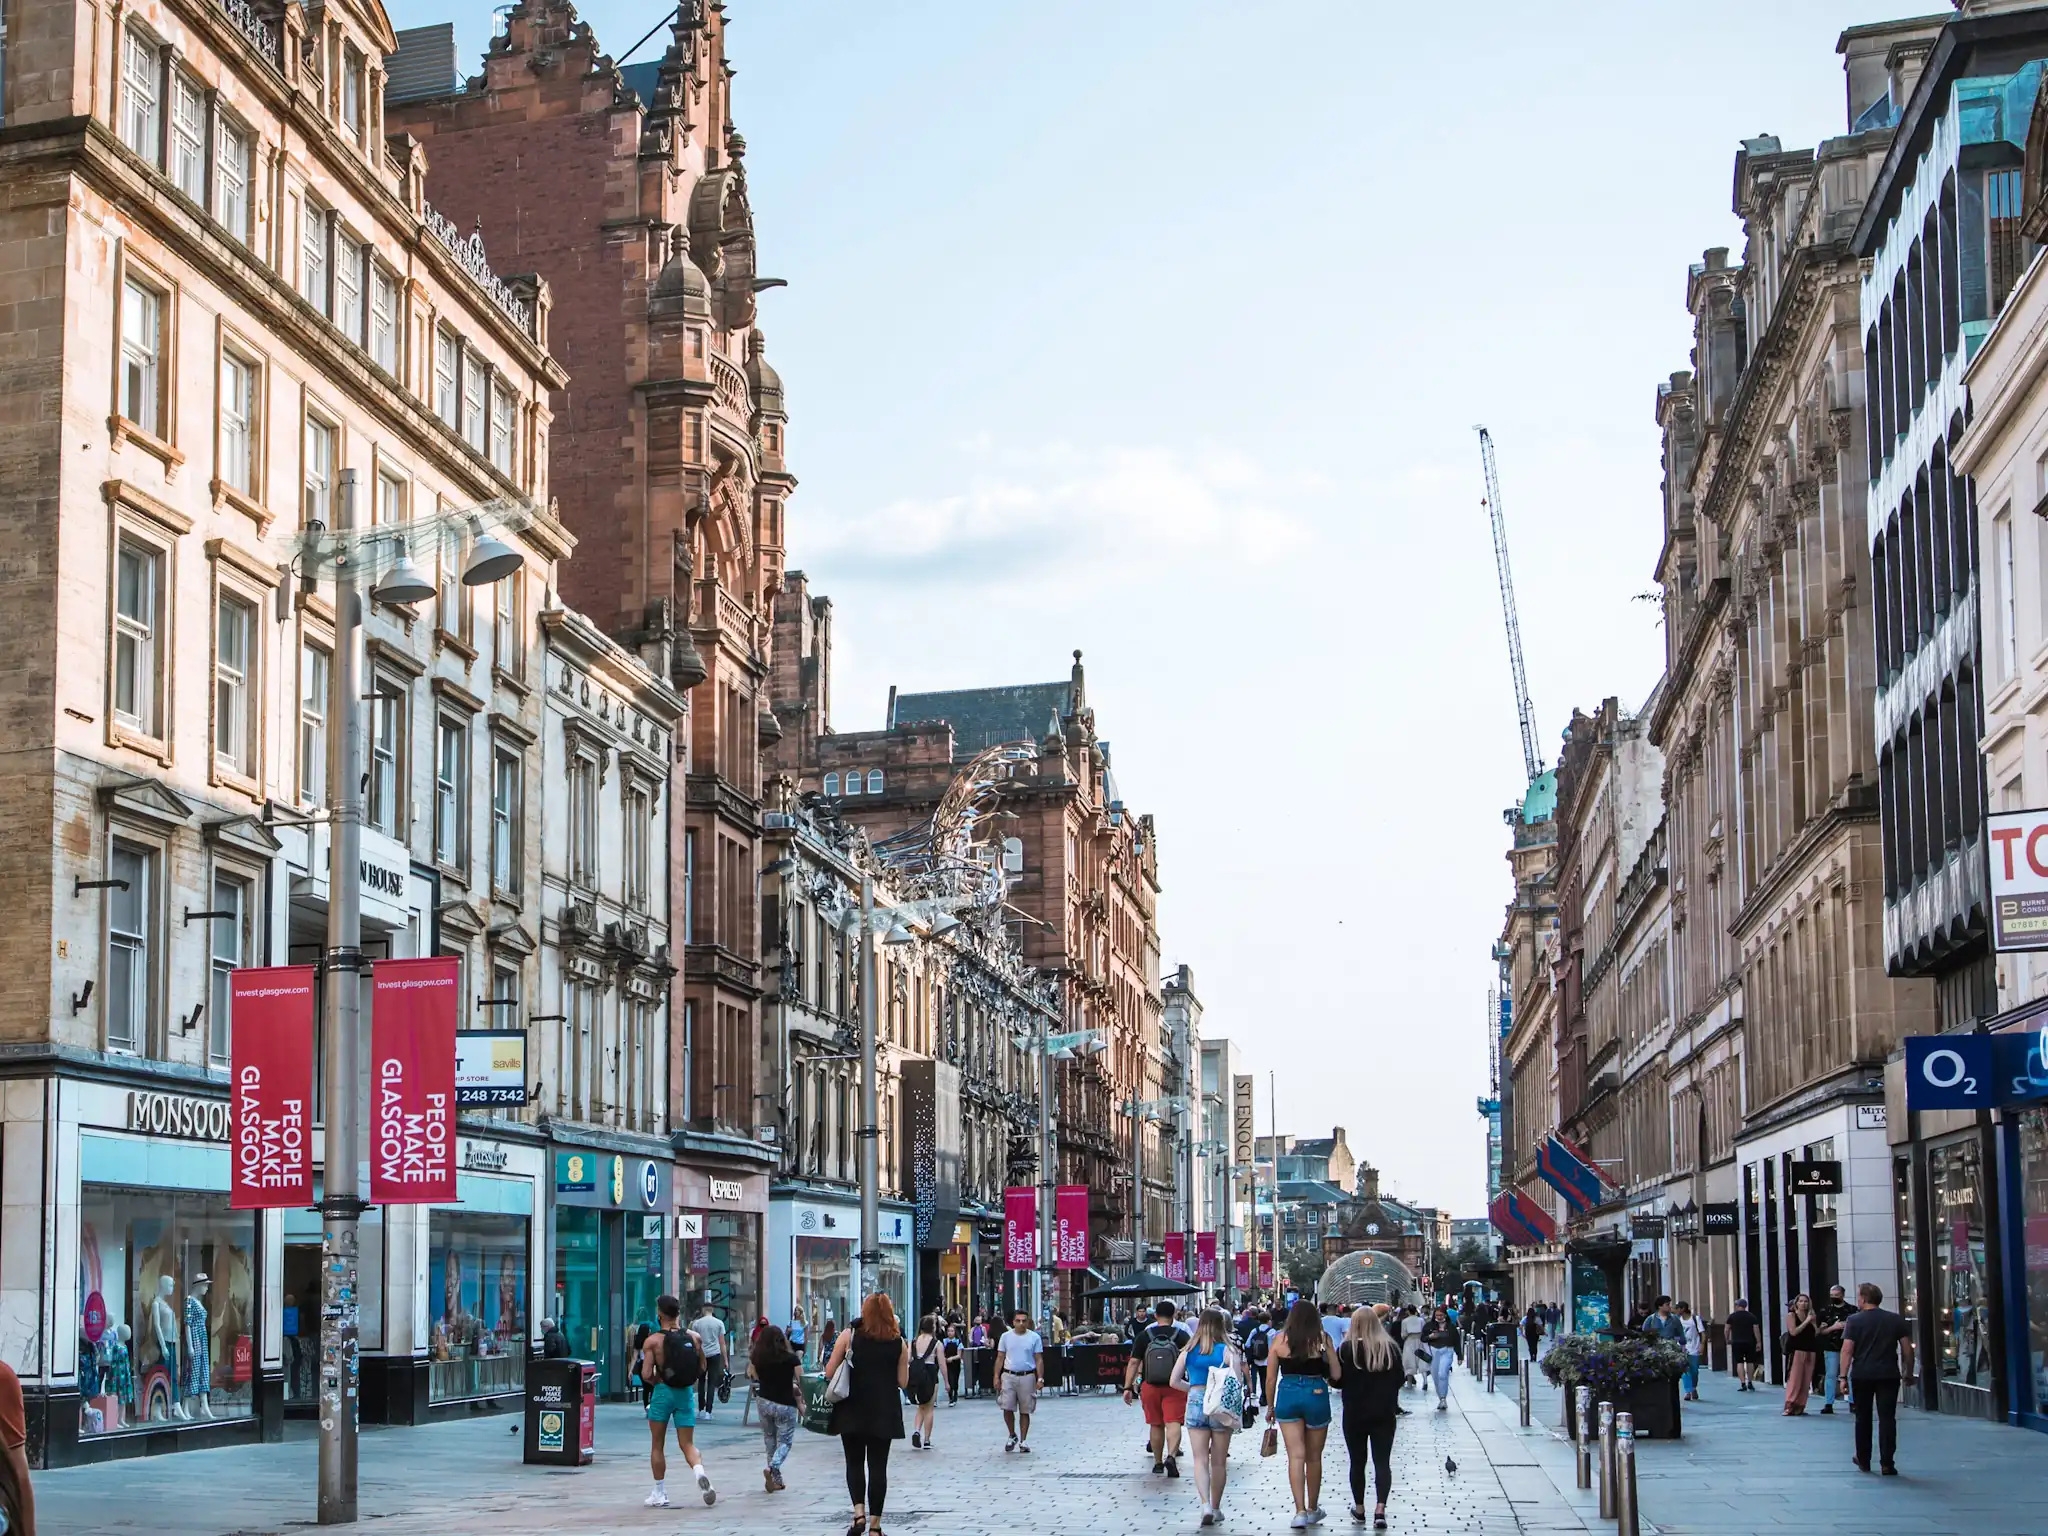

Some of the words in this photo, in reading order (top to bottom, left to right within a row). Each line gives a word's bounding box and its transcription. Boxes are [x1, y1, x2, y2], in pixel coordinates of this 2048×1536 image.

[368, 863, 404, 897] HOUSE
[2021, 899, 2046, 907] BURNS
[2010, 920, 2038, 929] 07887
[493, 1058, 521, 1069] savills
[461, 1090, 488, 1102] 248
[491, 1090, 524, 1102] 7342
[1236, 1081, 1251, 1100] ST
[240, 1065, 261, 1188] GLASGOW
[380, 1058, 403, 1183] GLASGOW
[1873, 1114, 1886, 1122] LA
[282, 1099, 303, 1187] PEOPLE
[403, 1113, 424, 1183] MAKE
[426, 1093, 446, 1182] PEOPLE
[261, 1119, 281, 1188] MAKE
[647, 1174, 656, 1192] BT
[709, 1175, 743, 1201] NESPRESSO
[1008, 1220, 1017, 1263] GLASGOW
[1016, 1239, 1025, 1263] MAKE
[1024, 1232, 1033, 1263] PEOPLE
[1060, 1219, 1069, 1262] GLASGOW
[1069, 1237, 1077, 1262] MAKE
[1076, 1231, 1085, 1262] PEOPLE
[236, 1348, 250, 1363] Sale
[1098, 1354, 1118, 1362] The
